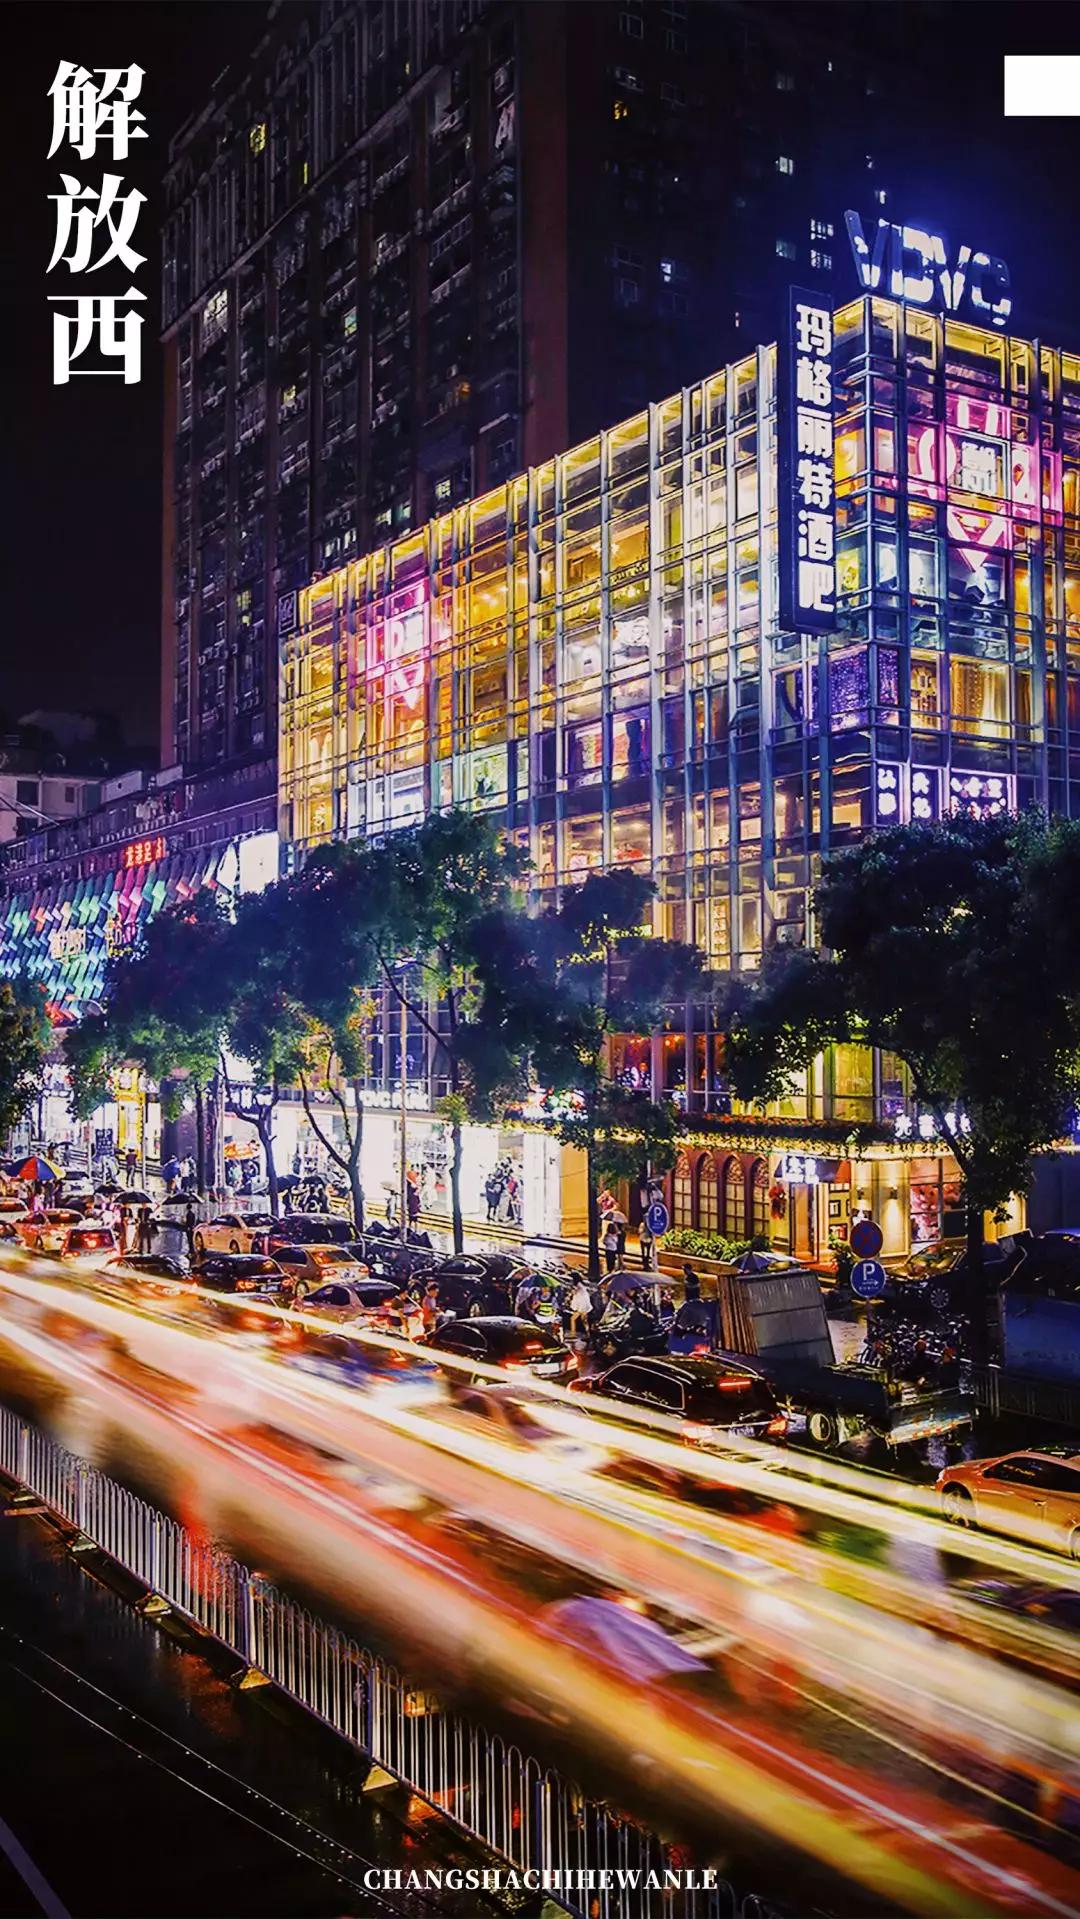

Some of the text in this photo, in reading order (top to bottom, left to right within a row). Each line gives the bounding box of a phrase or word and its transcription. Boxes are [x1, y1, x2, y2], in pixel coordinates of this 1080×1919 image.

[796, 303, 835, 613] 玛格丽特酒吧
[653, 1206, 663, 1221] P
[862, 1262, 876, 1281] P
